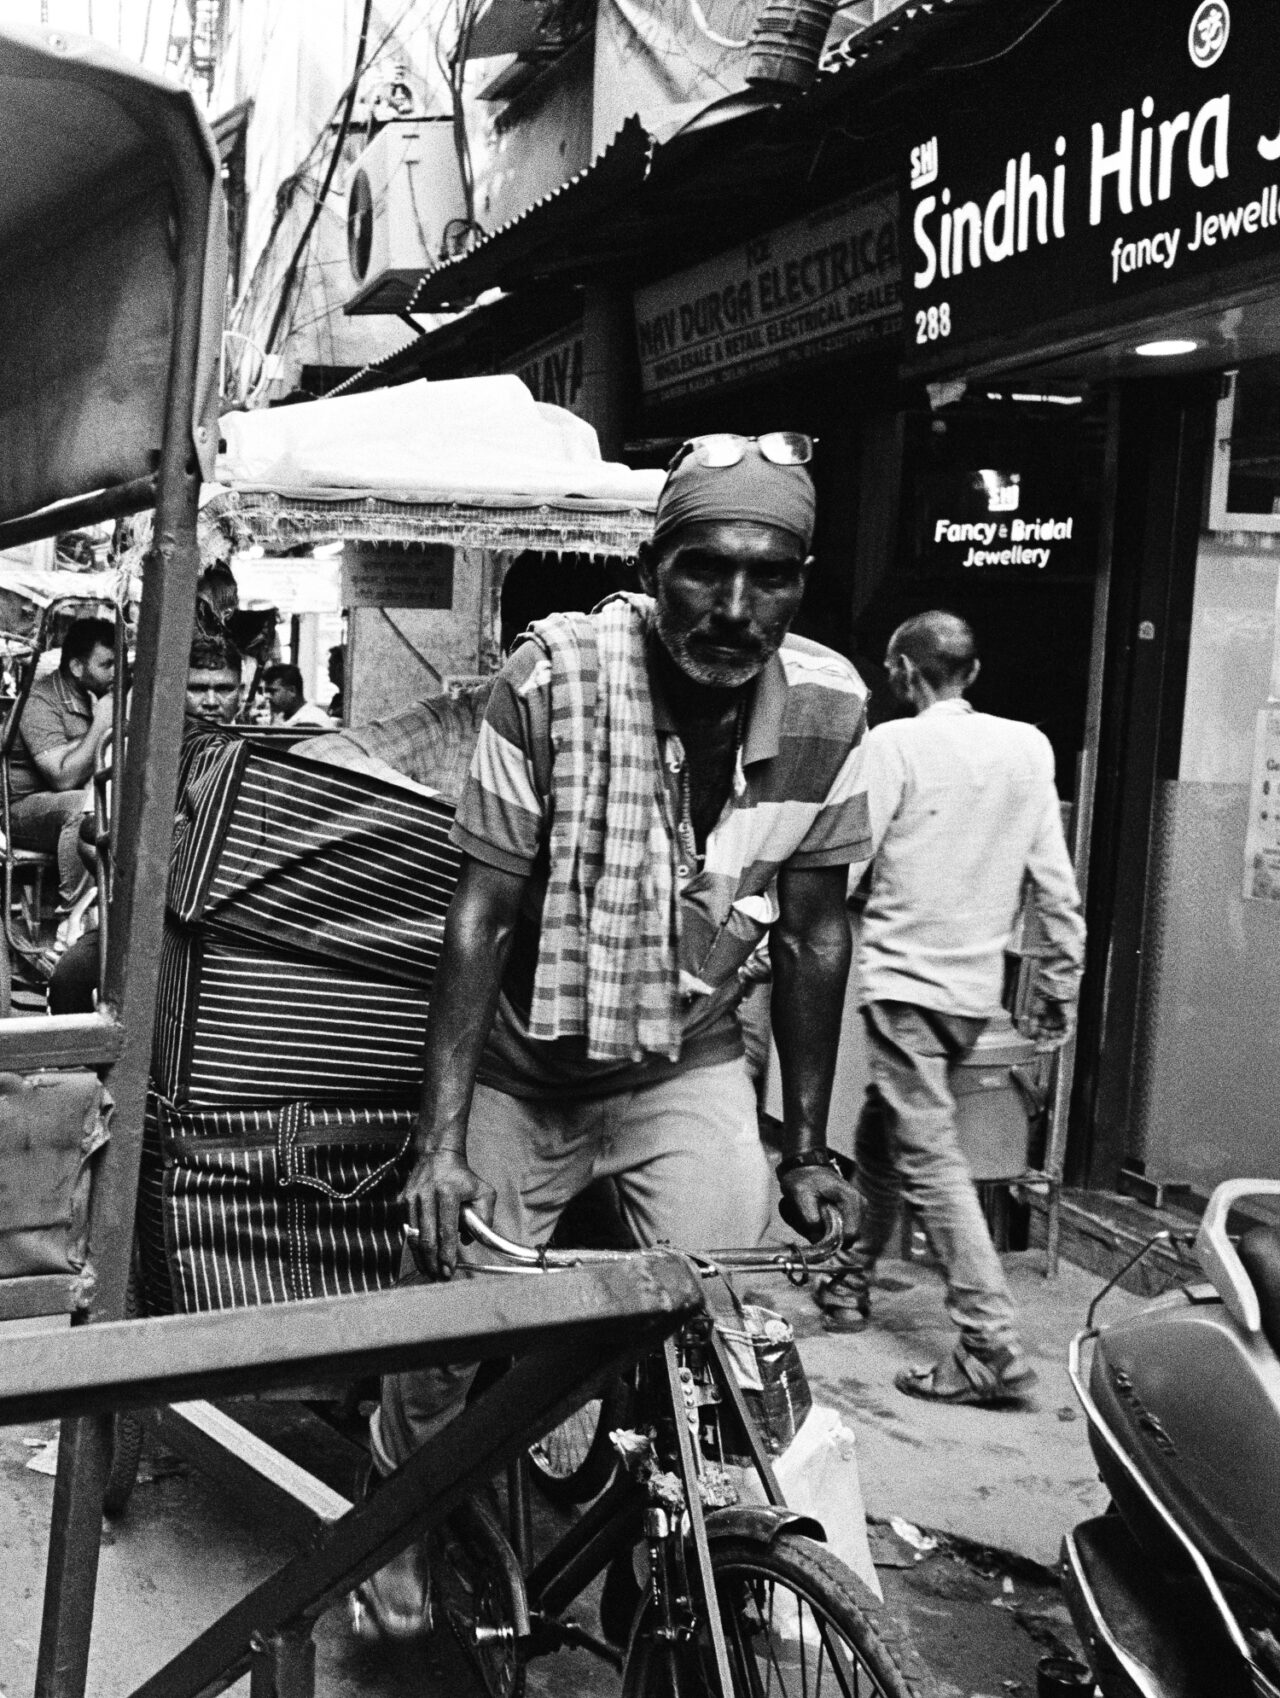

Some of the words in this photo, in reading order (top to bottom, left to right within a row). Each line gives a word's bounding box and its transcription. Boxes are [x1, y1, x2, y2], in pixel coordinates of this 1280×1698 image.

[913, 135, 1066, 290] Sindhi
[1089, 93, 1231, 226] Hira
[1111, 227, 1181, 284] fancy
[1187, 184, 1280, 251] Jewell
[680, 279, 755, 335] DURGA
[915, 302, 951, 344] 288
[934, 519, 997, 545] Fancy
[1010, 517, 1073, 541] Bridal
[962, 545, 1051, 569] Jewellery
